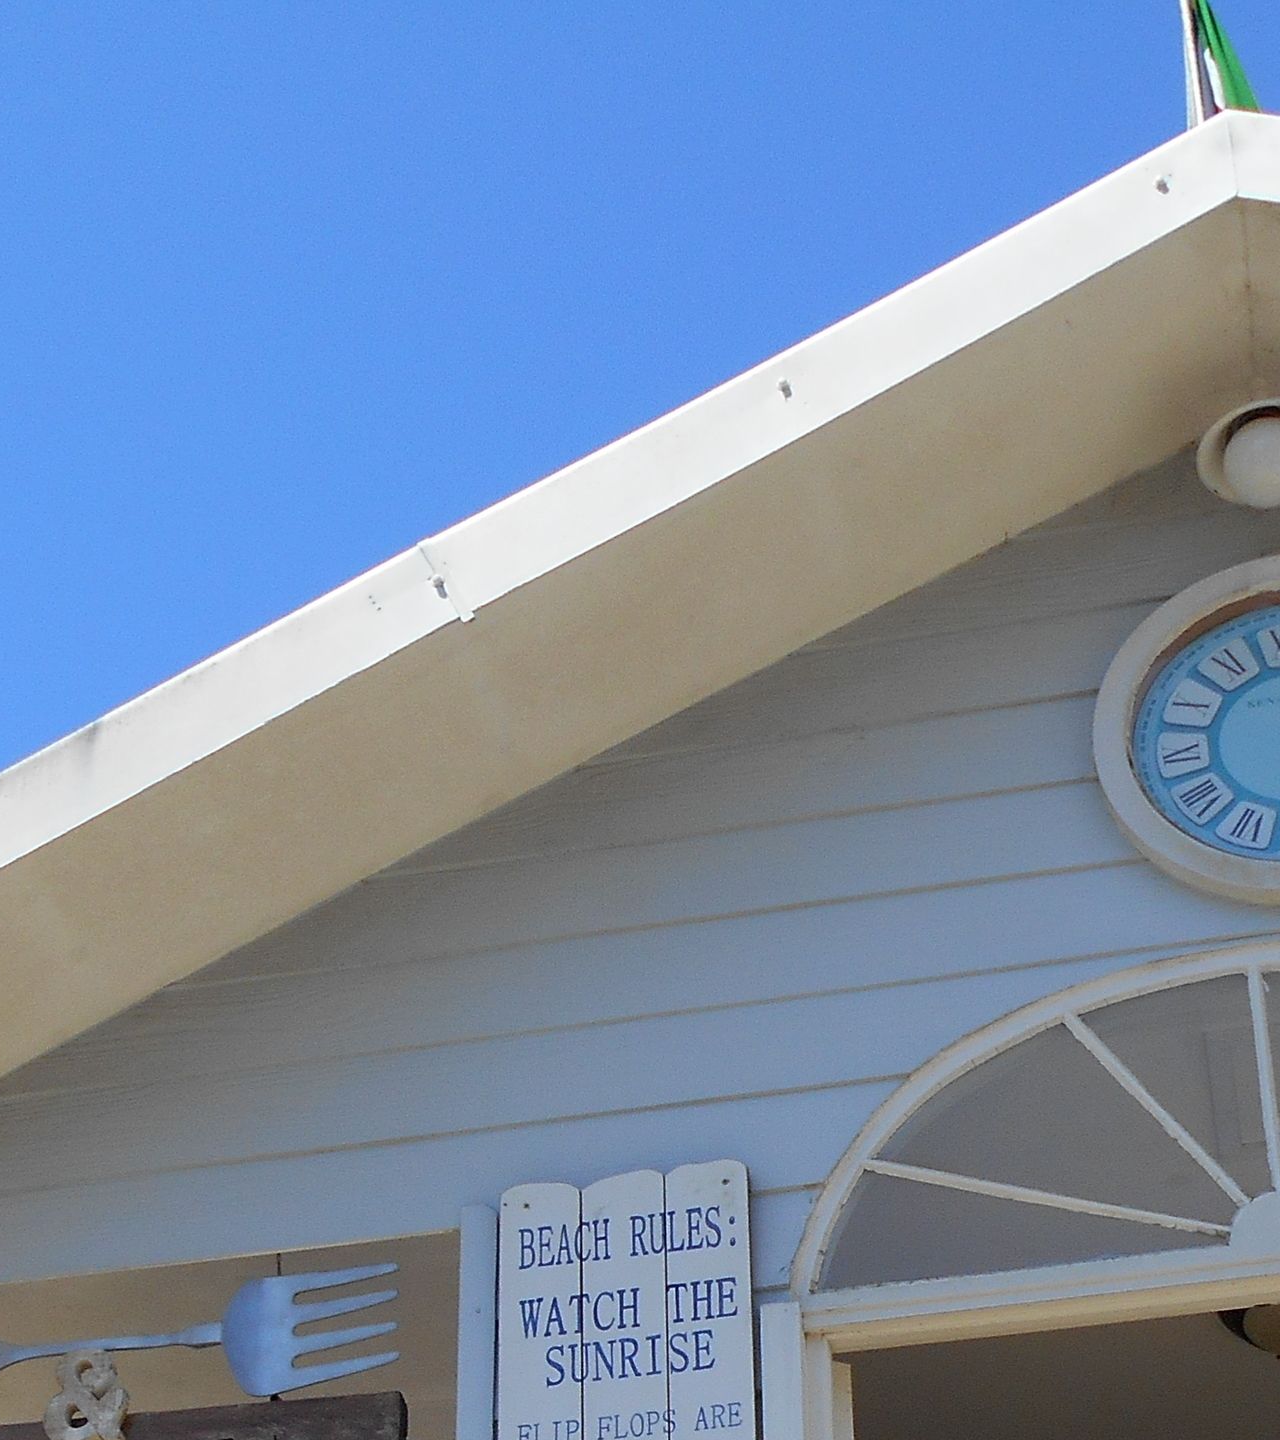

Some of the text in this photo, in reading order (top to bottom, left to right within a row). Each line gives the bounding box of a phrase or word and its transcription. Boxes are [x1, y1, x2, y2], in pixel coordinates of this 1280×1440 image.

[518, 1205, 738, 1271] BEACH RULES:
[519, 1276, 739, 1339] WATCH THE
[545, 1328, 716, 1388] SUNRISE
[597, 1408, 677, 1440] FLOPS
[694, 1401, 743, 1432] ARE
